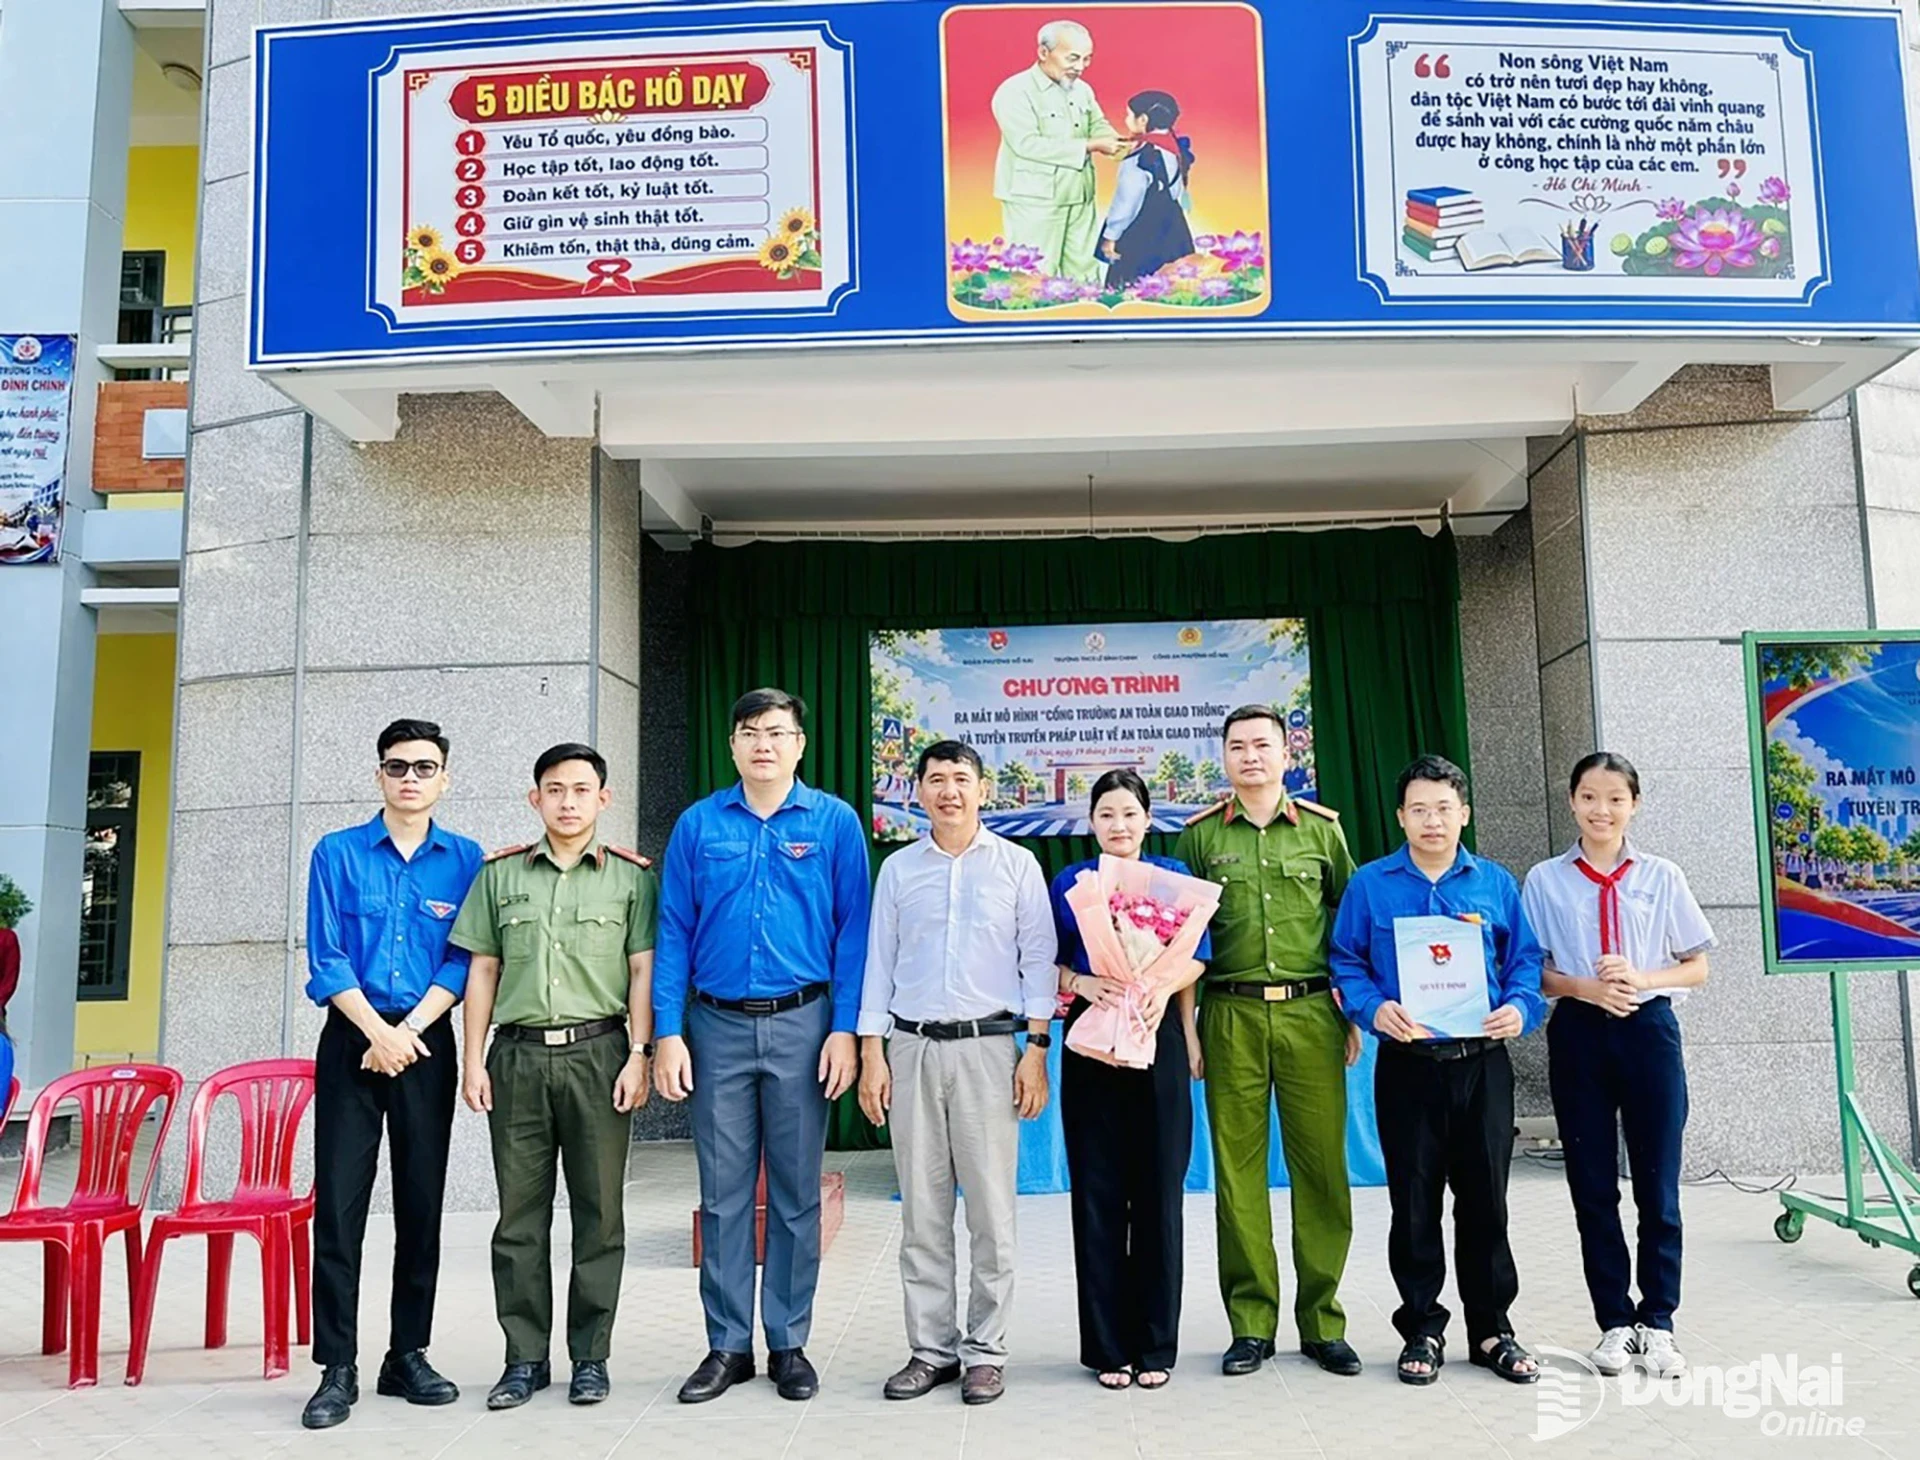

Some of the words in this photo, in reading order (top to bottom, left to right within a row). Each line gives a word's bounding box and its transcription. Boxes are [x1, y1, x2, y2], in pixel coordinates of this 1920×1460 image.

[1499, 53, 1535, 69] Non
[1541, 54, 1583, 73] sông
[1588, 55, 1625, 74] Việt
[1629, 56, 1669, 73] Nam
[476, 84, 497, 117] 5
[506, 73, 569, 114] ĐIỀU
[578, 73, 635, 111] BÁC
[645, 67, 683, 107] HỒ
[692, 74, 747, 109] DẠY
[1465, 73, 1484, 88] có
[1490, 74, 1516, 89] trở
[1520, 76, 1550, 90] nên
[1555, 75, 1588, 90] tươi
[1593, 76, 1622, 94] đẹp
[1627, 76, 1655, 95] hay
[1660, 78, 1713, 97] không,
[1410, 91, 1441, 107] dân
[1446, 92, 1473, 111] tộc
[1477, 92, 1512, 111] Việt
[1517, 93, 1554, 109] Nam
[1559, 94, 1578, 109] có
[1583, 95, 1622, 110] bước
[1626, 96, 1647, 111] tới
[1652, 97, 1676, 112] đài
[1680, 98, 1713, 113] vinh
[1718, 102, 1765, 118] quang
[1421, 109, 1441, 127] để
[1446, 112, 1485, 127] sánh
[1490, 114, 1513, 128] vai
[1518, 114, 1543, 128] với
[1548, 114, 1575, 129] các
[1580, 114, 1630, 134] cường
[1634, 114, 1673, 134] quốc
[1678, 117, 1712, 133] năm
[1717, 118, 1754, 134] châu
[465, 135, 475, 152] 1
[503, 134, 532, 149] Yêu
[538, 129, 558, 147] Tổ
[564, 128, 610, 148] quốc,
[615, 128, 645, 146] yêu
[699, 125, 735, 140] bào.
[1416, 132, 1456, 151] được
[1461, 132, 1491, 151] hay
[1496, 133, 1552, 152] không,
[1557, 134, 1600, 150] chính
[1606, 134, 1620, 150] là
[1625, 135, 1656, 151] nhờ
[1661, 136, 1692, 156] một
[1741, 138, 1765, 155] lớn
[464, 163, 477, 179] 2
[503, 163, 536, 179] Học
[542, 160, 569, 177] tập
[574, 156, 603, 173] tốt,
[610, 157, 635, 171] lao
[641, 154, 684, 172] động
[690, 152, 719, 168] tốt.
[1478, 153, 1490, 169] ở
[1495, 154, 1535, 172] công
[1539, 154, 1568, 173] học
[1573, 155, 1601, 173] tập
[1606, 155, 1634, 171] của
[1639, 157, 1666, 172] các
[1671, 160, 1699, 173] em.
[464, 190, 477, 205] 3
[503, 187, 547, 203] Đoàn
[553, 184, 579, 200] kết
[585, 183, 614, 200] tốt,
[620, 182, 640, 199] kỷ
[646, 181, 679, 198] luật
[684, 179, 714, 195] tốt.
[1571, 176, 1598, 191] Chí
[1601, 177, 1643, 192] Minh
[463, 217, 477, 233] 4
[503, 215, 534, 231] Giữ
[538, 214, 563, 232] gìn
[569, 212, 589, 229] vệ
[594, 211, 629, 226] sinh
[635, 209, 669, 226] thật
[675, 206, 704, 222] tốt.
[464, 244, 477, 260] 5
[503, 242, 554, 257] Khiêm
[559, 239, 590, 255] tốn,
[596, 238, 628, 255] thật
[634, 237, 666, 253] thà,
[671, 236, 711, 251] dũng
[716, 233, 755, 249] cảm.
[31, 379, 65, 392] CHINH
[1003, 676, 1108, 698] CHƯƠNG
[1111, 671, 1180, 695] TRÌNH
[954, 711, 969, 724] RA
[971, 707, 992, 723] MẮT
[994, 707, 1011, 723] MÔ
[1013, 706, 1039, 722] HÌNH
[1076, 704, 1117, 720] TRƯỜNG
[1120, 707, 1134, 719] AN
[1136, 703, 1162, 719] TOÀN
[1164, 705, 1189, 718] GIAO
[959, 730, 973, 744] VÀ
[975, 729, 1006, 744] TUYÊN
[1049, 726, 1077, 742] PHÁP
[1079, 726, 1104, 744] LUẬT
[1121, 728, 1135, 740] AN
[1137, 724, 1163, 740] TOÀN
[1165, 727, 1191, 739] GIAO
[1826, 771, 1847, 786] RA
[1852, 765, 1885, 786] MẮT
[1890, 765, 1916, 785] MÔ
[1848, 796, 1896, 817] TUYÊN
